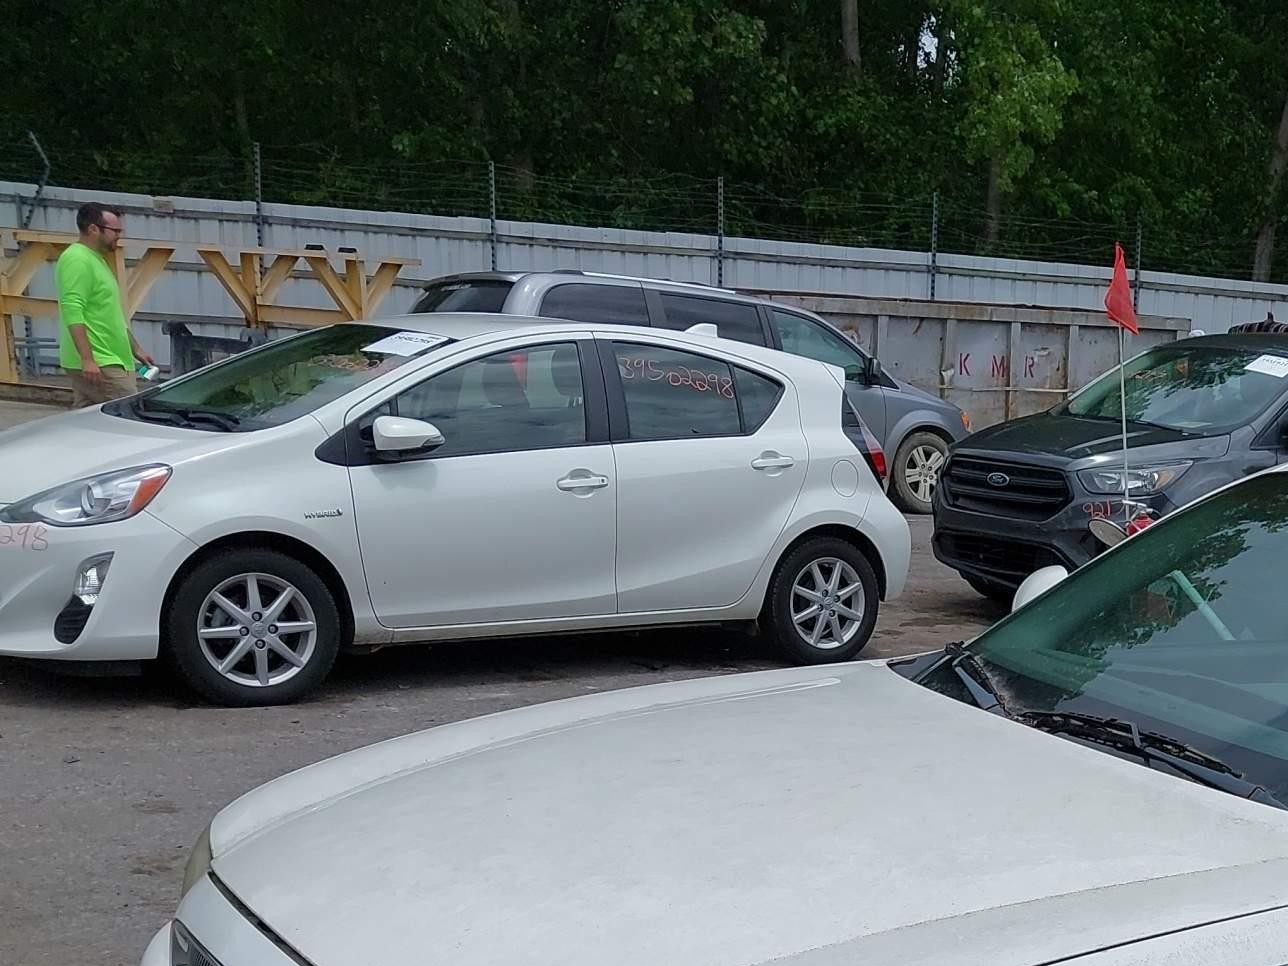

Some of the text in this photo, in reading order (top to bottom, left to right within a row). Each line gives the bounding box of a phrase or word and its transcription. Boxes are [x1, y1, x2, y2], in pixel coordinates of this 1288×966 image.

[618, 357, 735, 399] 39502298
[959, 353, 1035, 378] K M R
